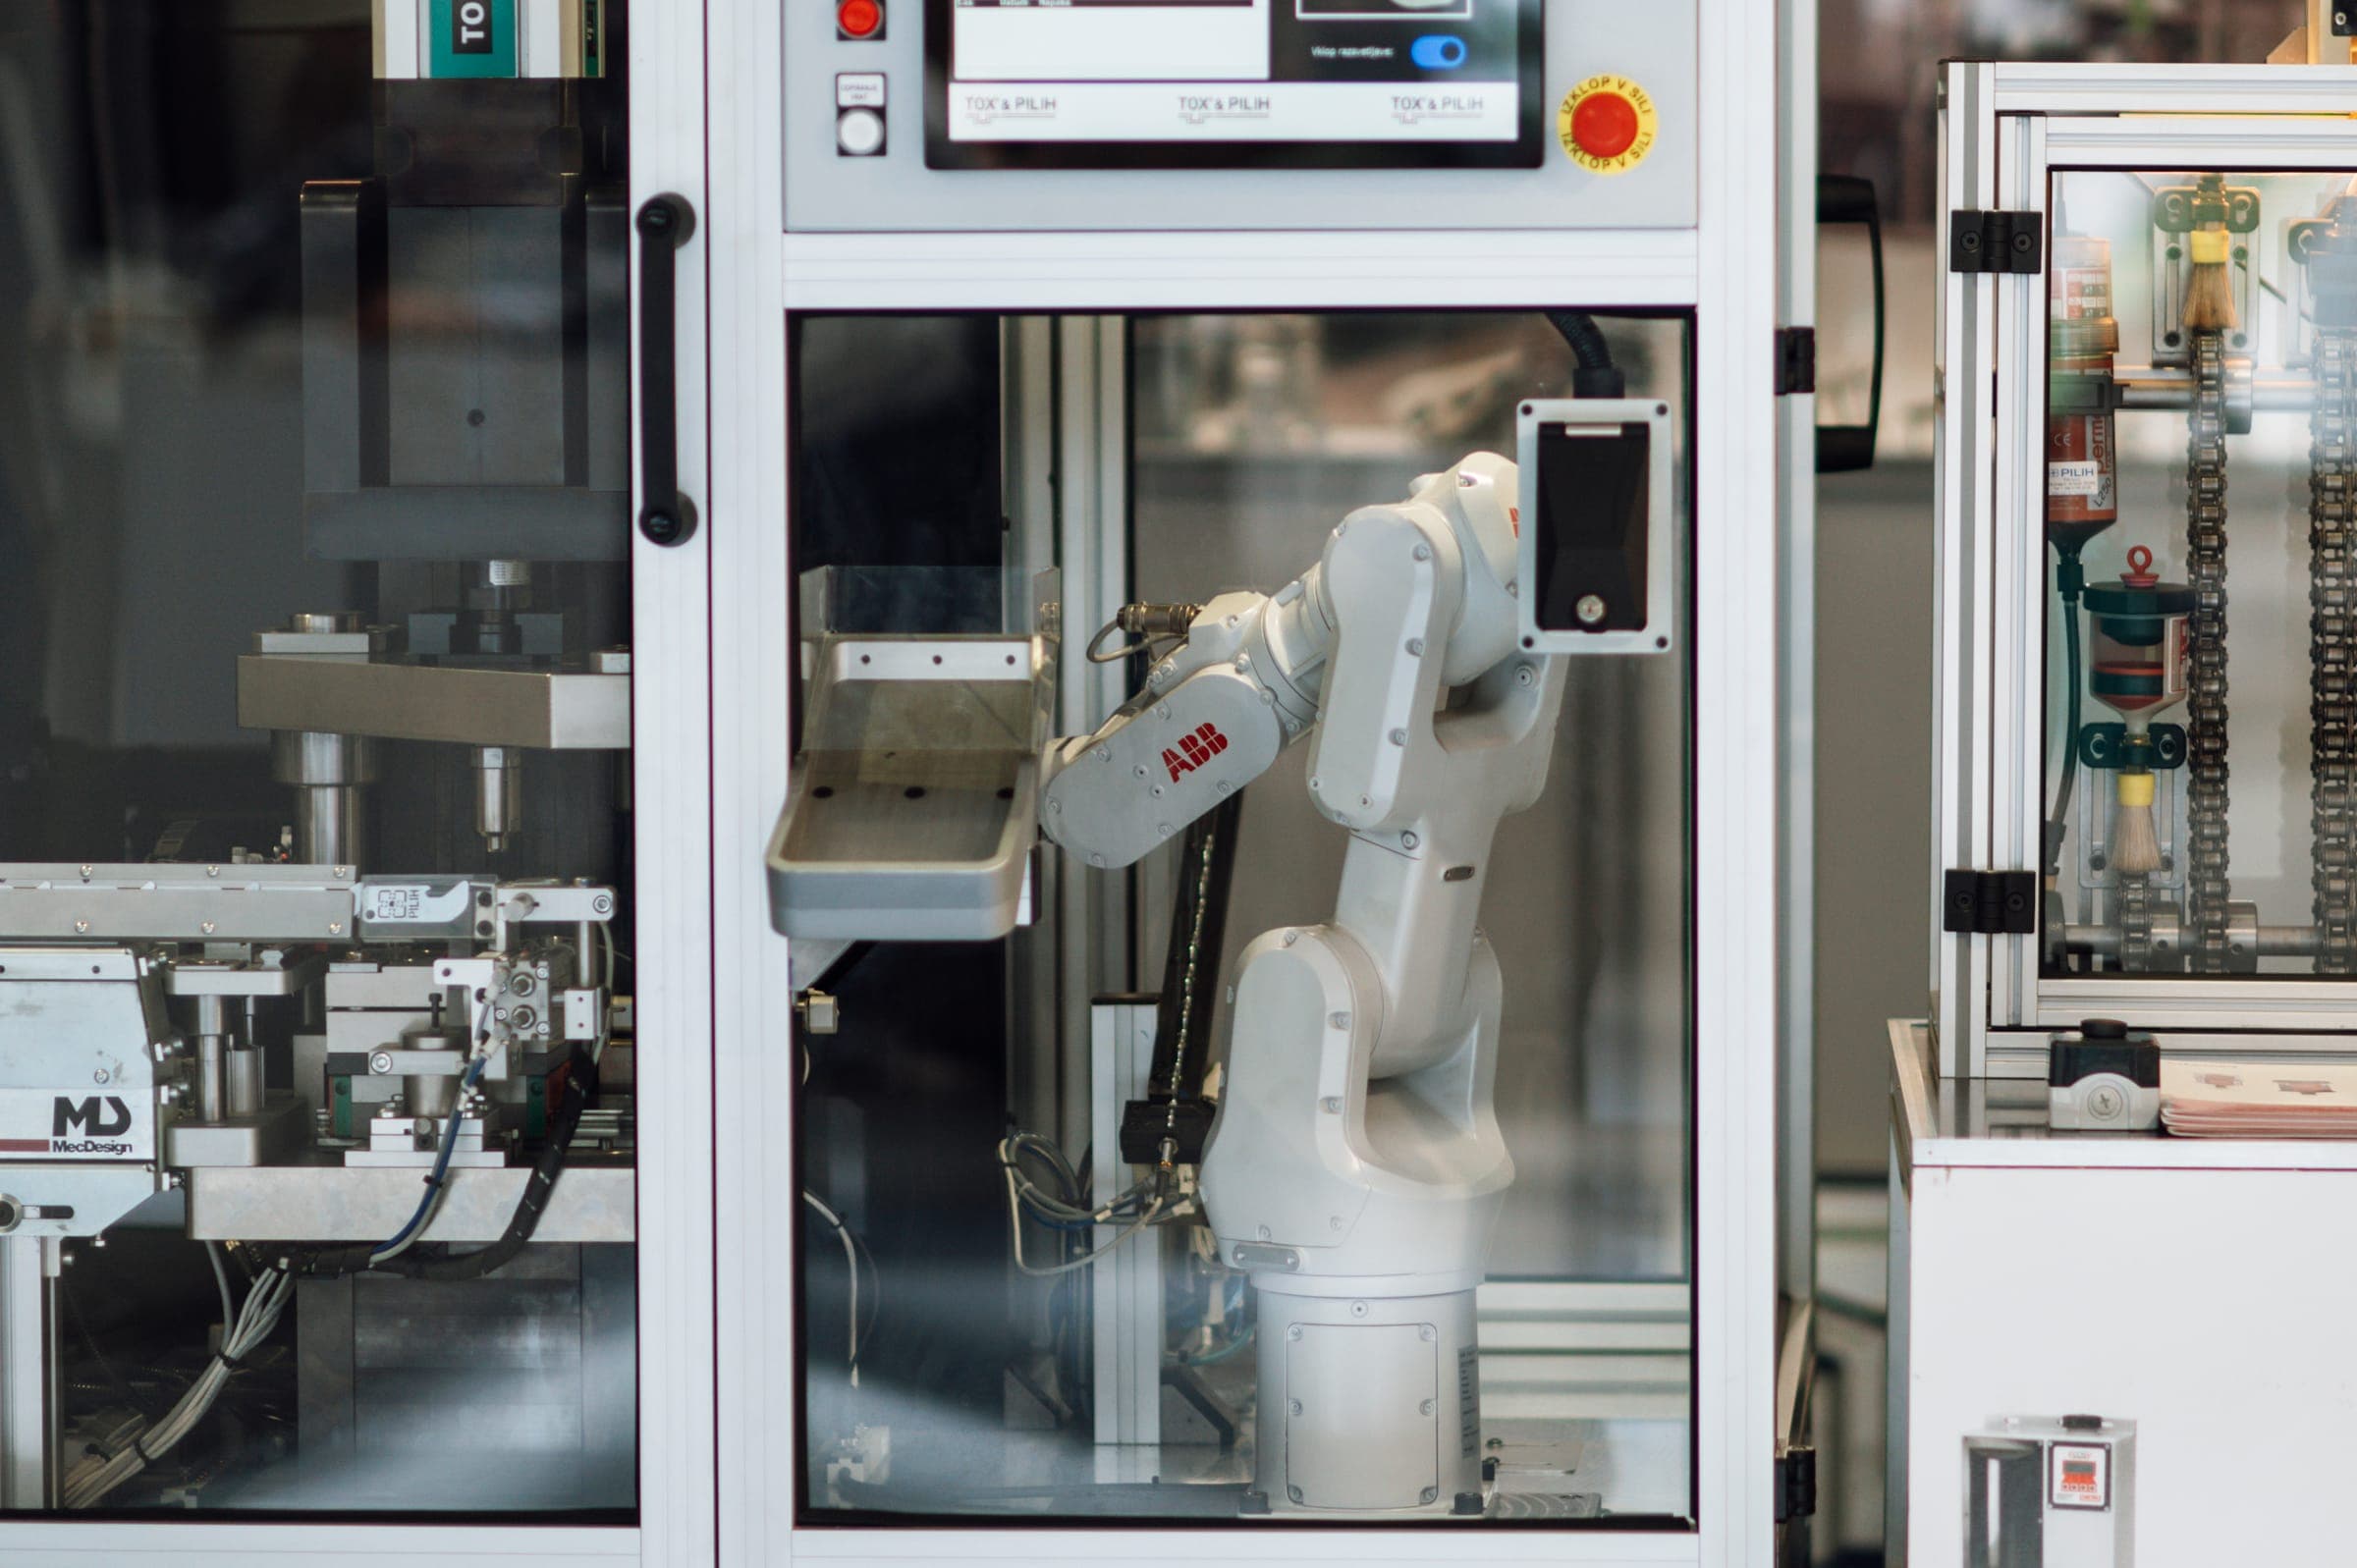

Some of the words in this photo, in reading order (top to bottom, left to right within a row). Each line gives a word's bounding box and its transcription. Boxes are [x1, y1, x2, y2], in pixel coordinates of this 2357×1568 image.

[1617, 79, 1626, 90] V
[1015, 97, 1056, 110] PILIH
[1230, 97, 1270, 110] PILIH
[1442, 96, 1483, 110] PILIH
[2060, 467, 2094, 477] PILIH
[1162, 723, 1228, 784] ABB
[409, 890, 419, 919] PILIH
[53, 1097, 132, 1136] MD
[53, 1140, 133, 1155] MecDesign
